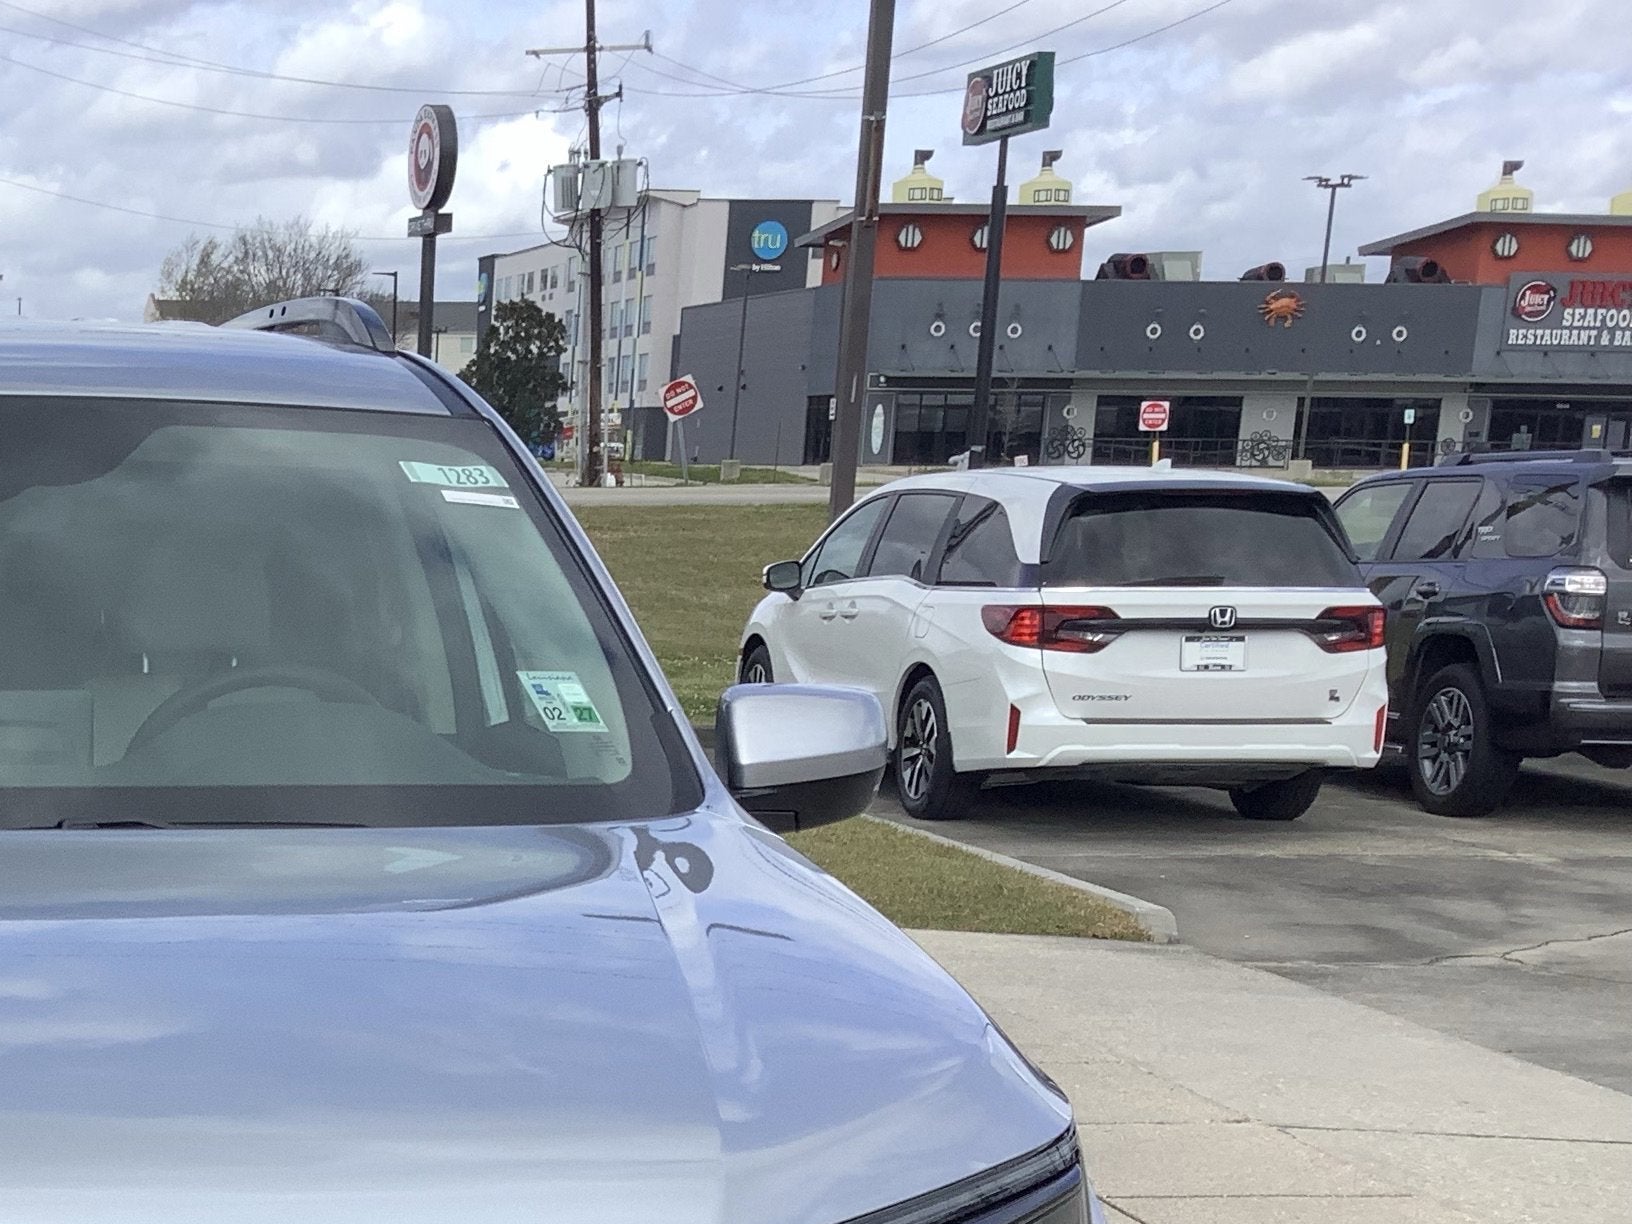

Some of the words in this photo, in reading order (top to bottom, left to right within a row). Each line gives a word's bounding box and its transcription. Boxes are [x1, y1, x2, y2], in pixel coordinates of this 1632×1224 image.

[988, 60, 1030, 96] JUICY
[987, 89, 1027, 116] SEAFOOD
[752, 229, 781, 249] tru
[1560, 280, 1632, 308] JUIC
[1562, 308, 1632, 328] SEAFOO
[1507, 329, 1598, 345] RESTAURANT
[1600, 331, 1610, 346] &
[1613, 331, 1632, 346] BA
[673, 399, 694, 413] ENTER
[437, 467, 490, 485] 1283
[543, 706, 567, 721] 02
[574, 708, 594, 721] 27
